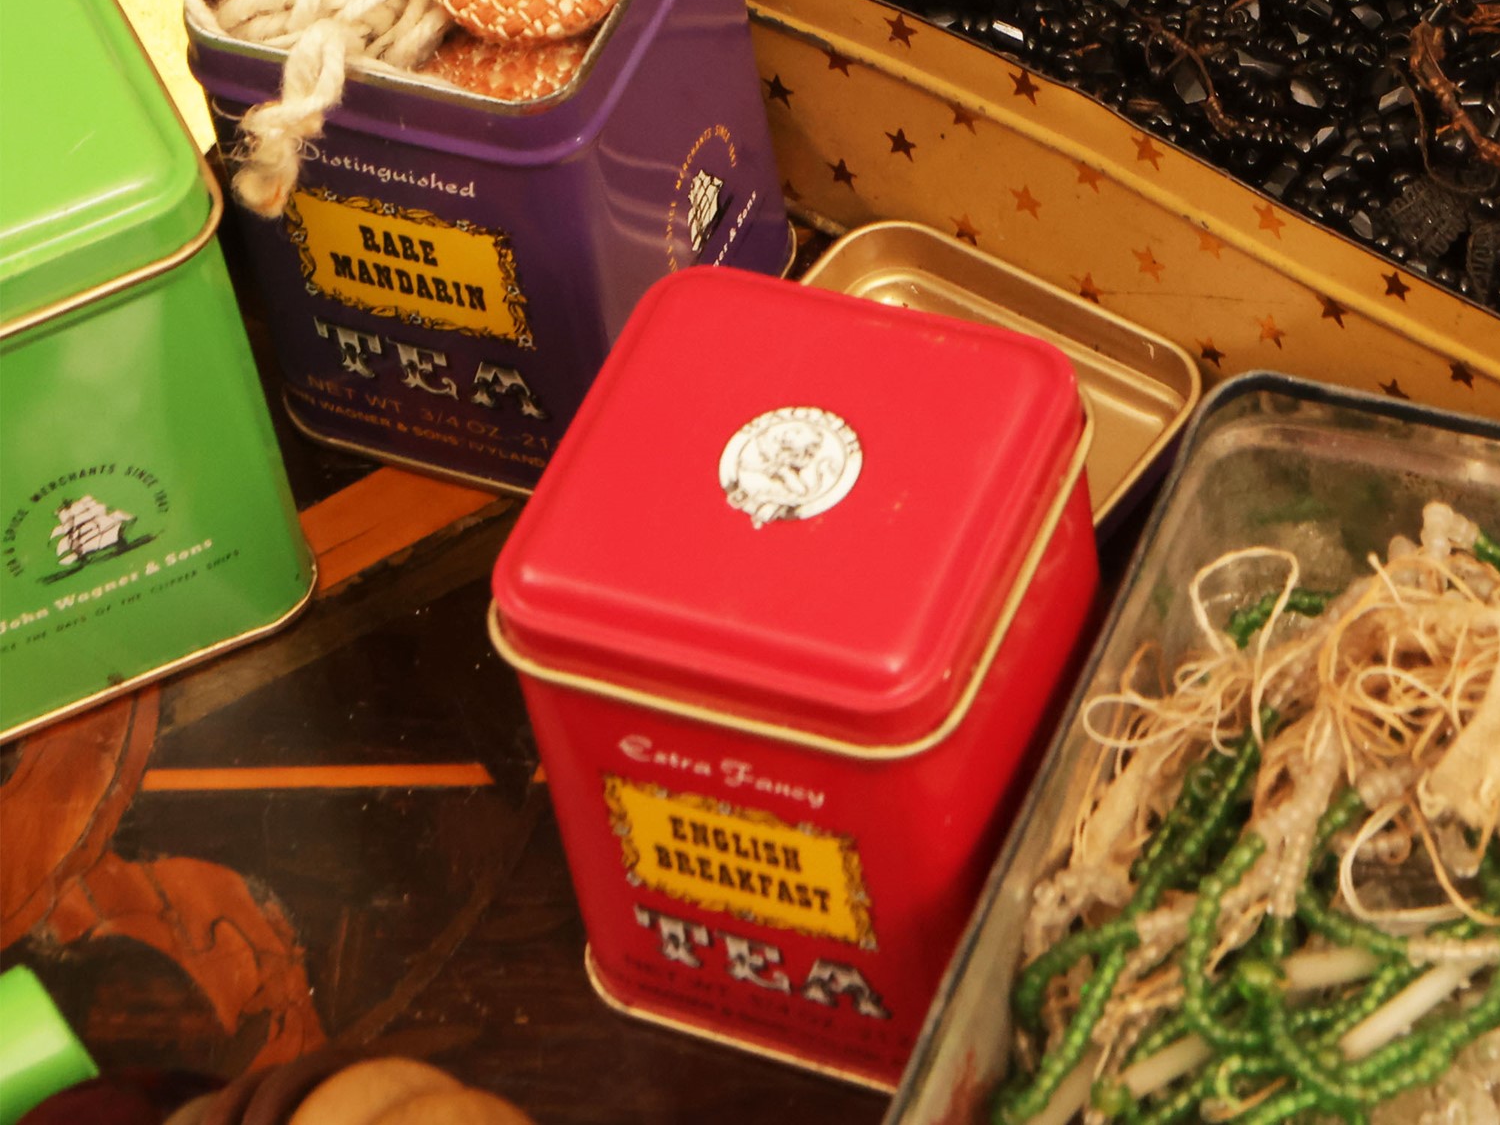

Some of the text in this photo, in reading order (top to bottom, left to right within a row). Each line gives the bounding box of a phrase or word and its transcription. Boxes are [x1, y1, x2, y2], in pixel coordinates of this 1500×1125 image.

[296, 139, 476, 198] Distinguished
[736, 190, 757, 228] Sons
[358, 224, 438, 267] RARE
[329, 251, 487, 312] MANDARIN
[306, 374, 356, 401] NET
[312, 315, 551, 421] TEA
[319, 400, 392, 429] WAGNER
[30, 463, 117, 503] MERCHANTS
[124, 465, 159, 488] SINCE
[54, 572, 139, 611] Wagner
[145, 560, 161, 576] &
[164, 538, 213, 567] Sons
[719, 757, 825, 810] Fancy
[668, 813, 804, 874] ENGLISH
[654, 843, 830, 915] BREAKFAST
[634, 902, 893, 1021] TEA
